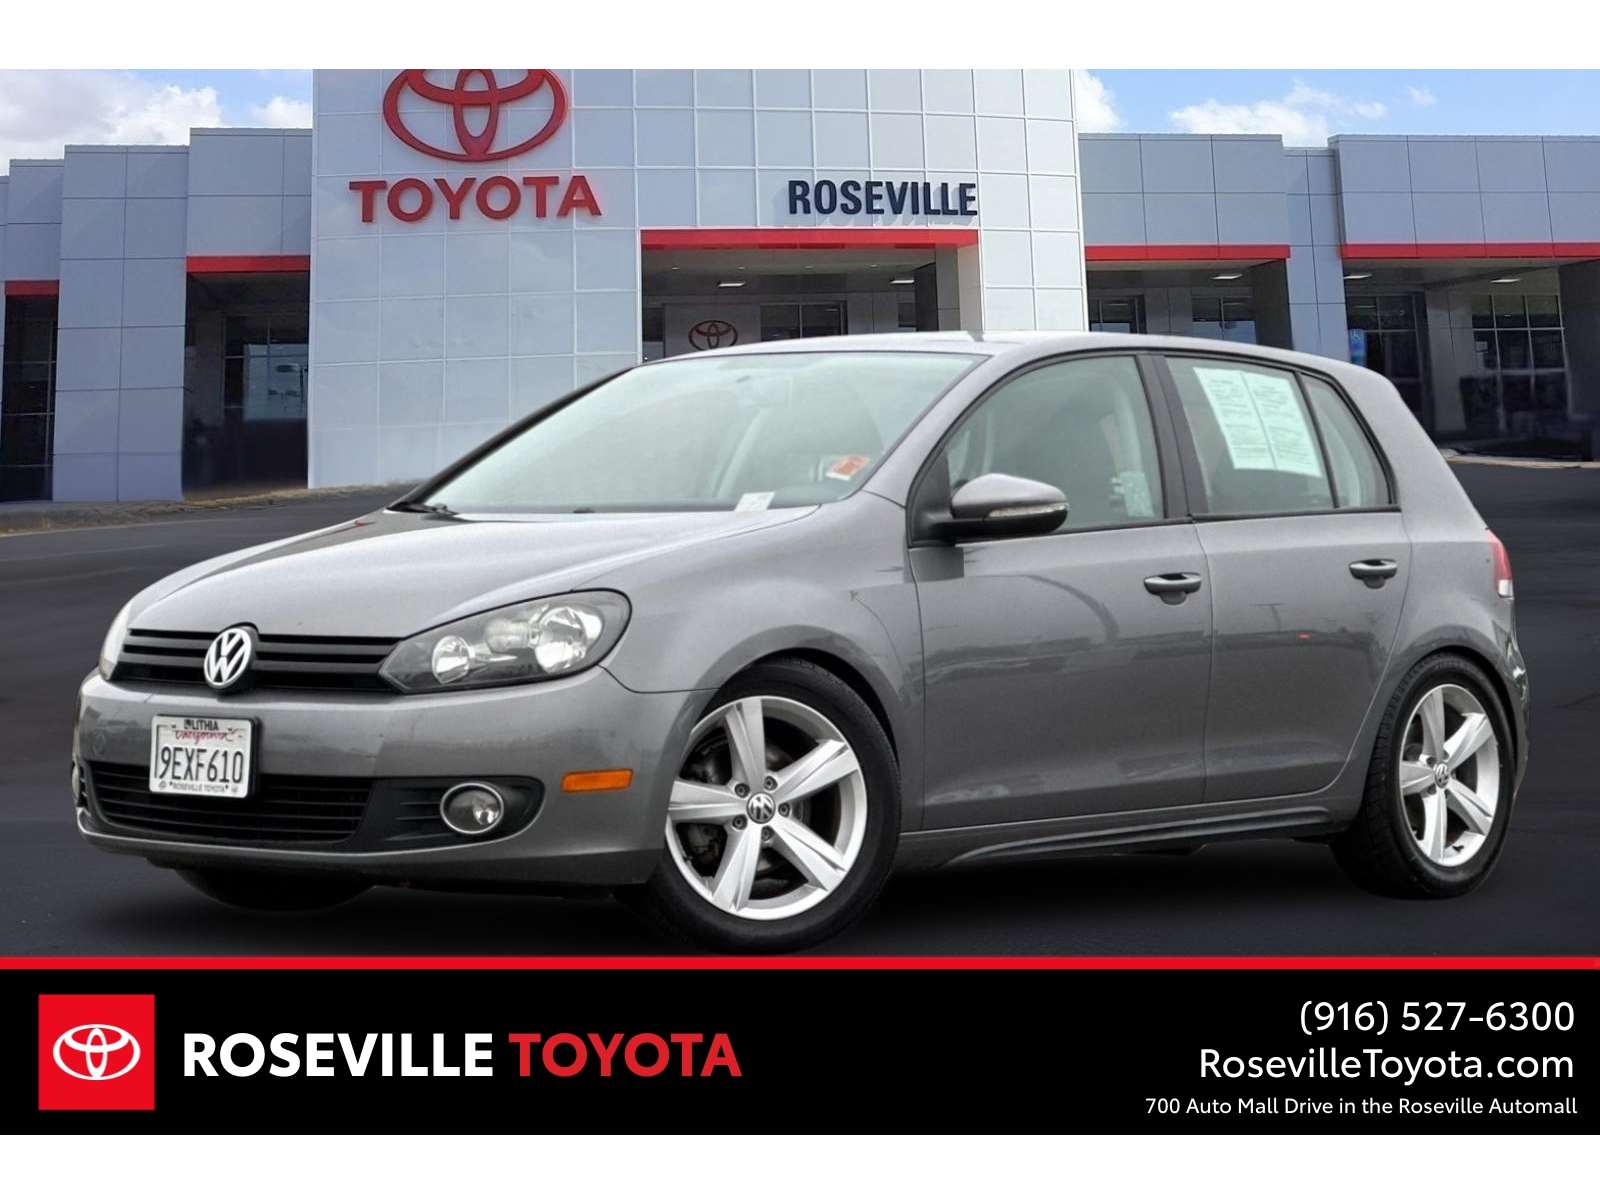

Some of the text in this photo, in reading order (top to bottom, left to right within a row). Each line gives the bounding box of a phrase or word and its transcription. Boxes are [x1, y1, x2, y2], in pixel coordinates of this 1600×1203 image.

[349, 175, 602, 223] TOYOTA
[788, 180, 978, 216] ROSEVILLE
[159, 746, 244, 783] 9EXF610
